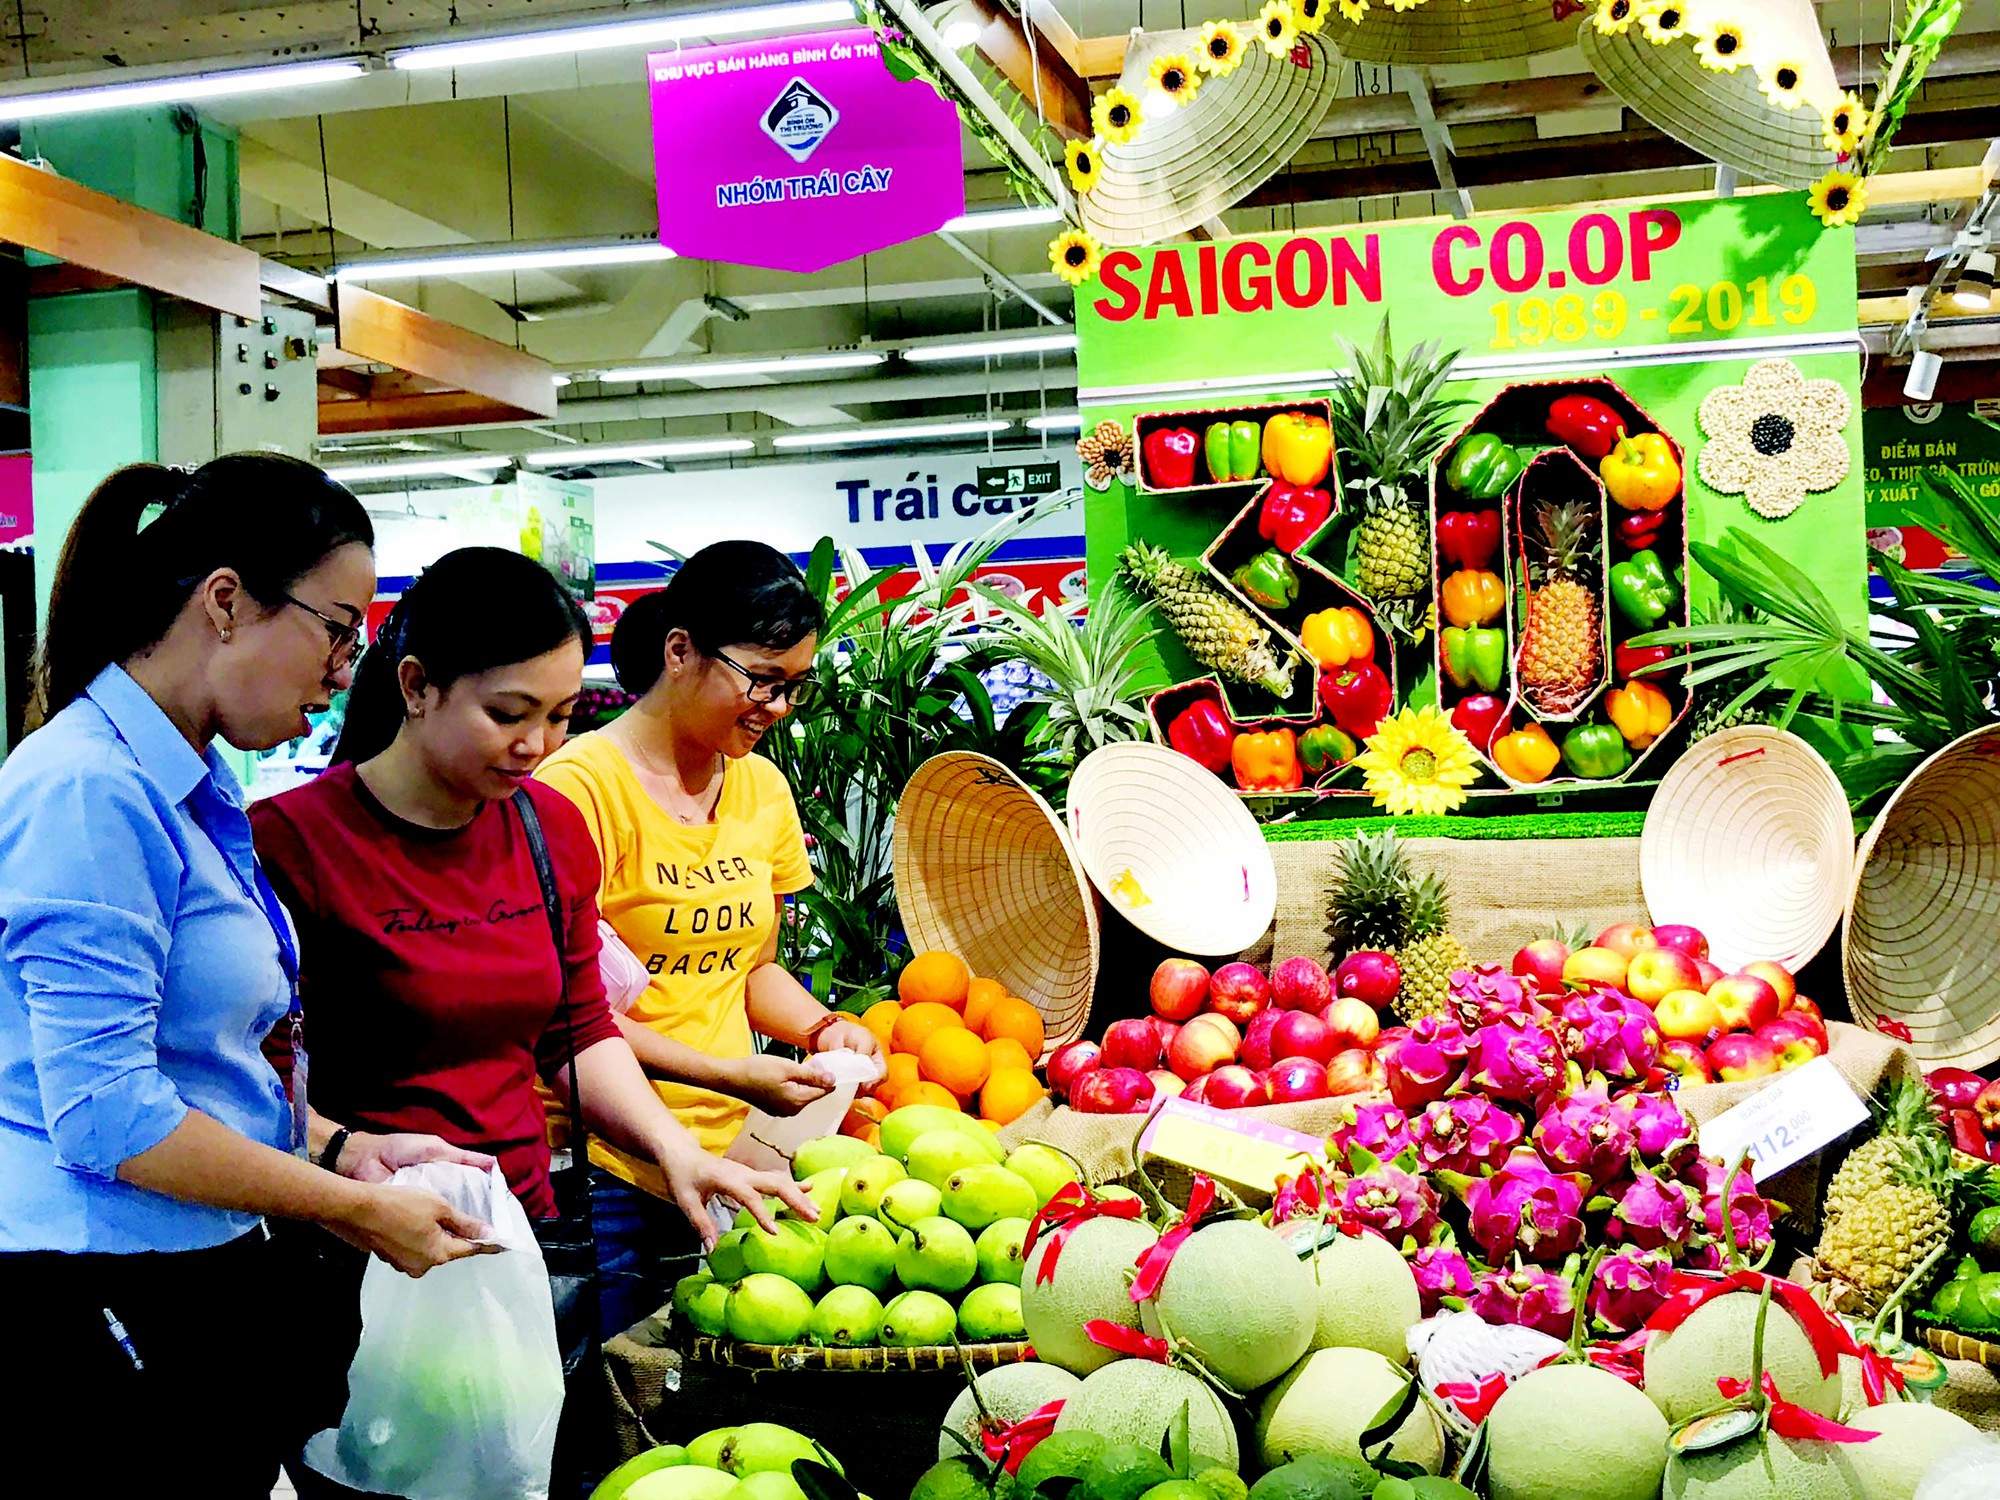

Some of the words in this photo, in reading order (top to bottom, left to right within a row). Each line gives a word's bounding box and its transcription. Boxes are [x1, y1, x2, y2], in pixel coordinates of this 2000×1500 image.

[655, 67, 683, 82] KHU
[685, 62, 715, 79] VỰC
[717, 57, 746, 74] BÁN
[749, 51, 790, 69] HÀNG
[792, 48, 827, 64] BÌNH
[854, 43, 879, 59] THỊ
[717, 176, 784, 206] NHÓM
[786, 168, 839, 198] TRÁI
[843, 165, 893, 193] CÂY
[1093, 233, 1383, 324] SAIGON
[1430, 208, 1683, 298] CO.OP
[1489, 291, 1628, 350] 1989
[1667, 273, 1817, 335] 2019
[1881, 438, 1920, 460] ĐIỂM
[1925, 439, 1958, 457] BÁN
[1027, 473, 1052, 485] EXIT
[1957, 458, 2000, 477] TRỨN
[836, 471, 939, 523] Trái
[1880, 482, 1919, 502] XUẤT
[656, 857, 754, 889] NEVER
[664, 901, 754, 935] LOOK
[645, 947, 742, 975] BACK
